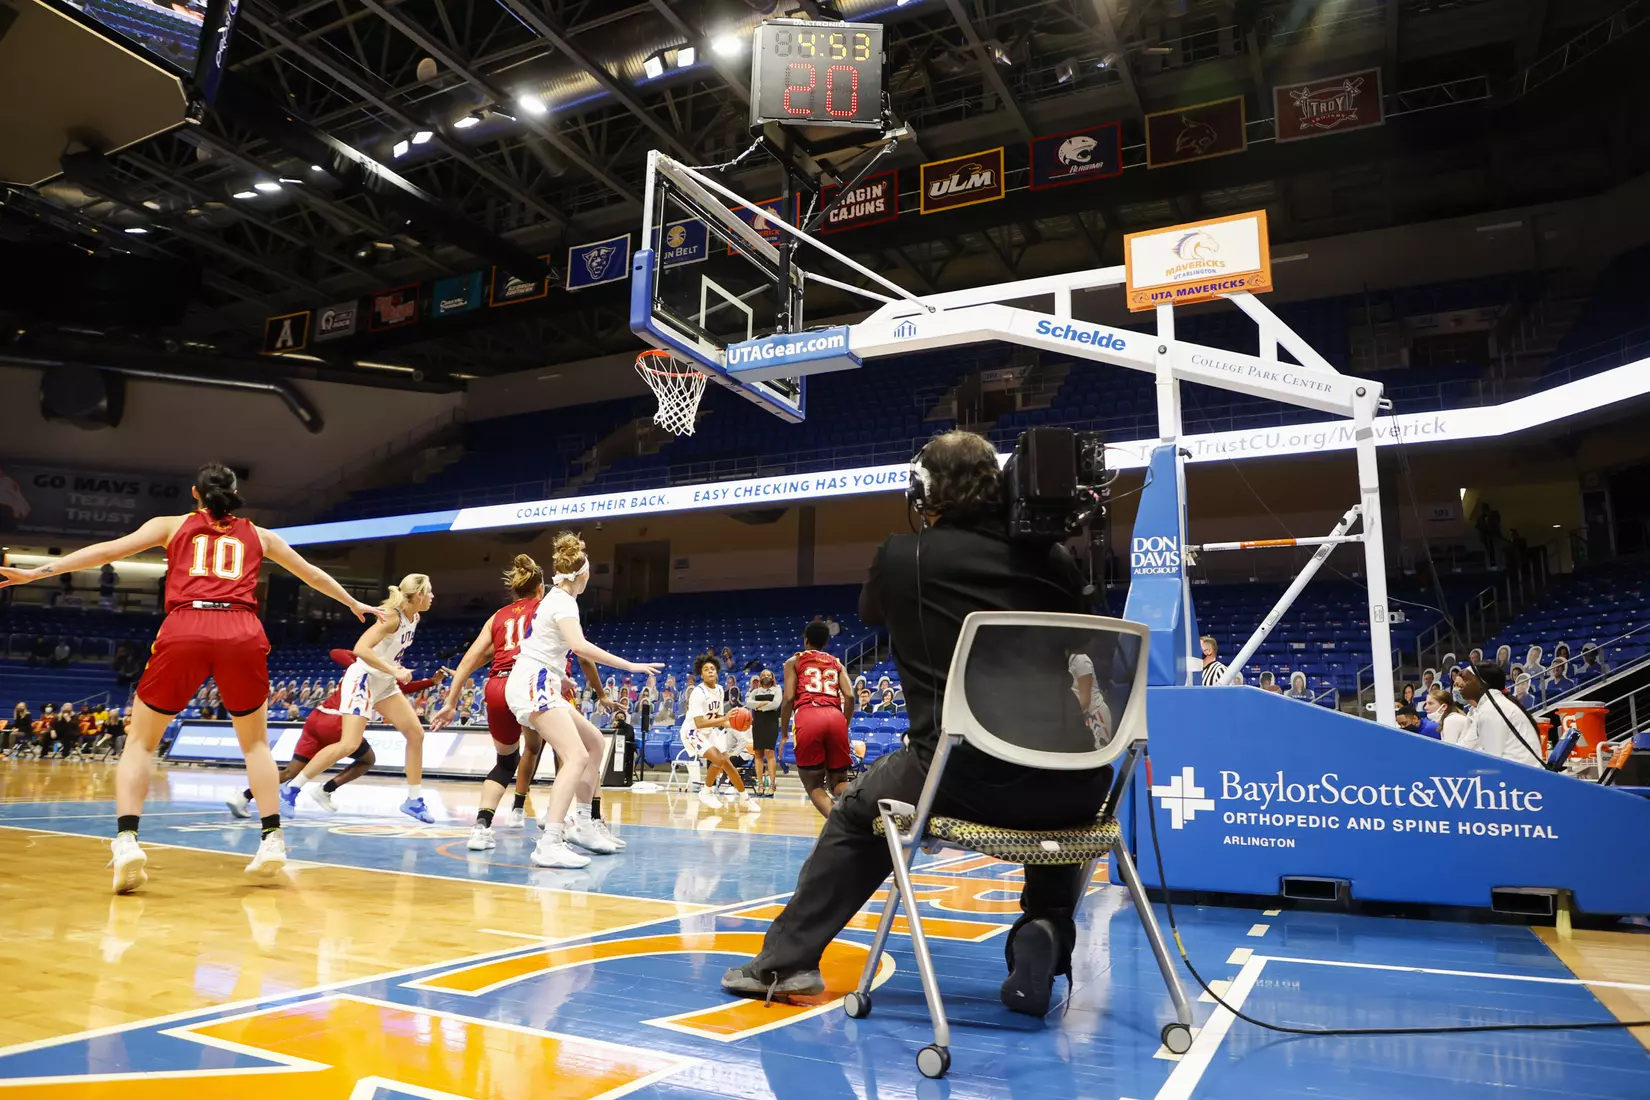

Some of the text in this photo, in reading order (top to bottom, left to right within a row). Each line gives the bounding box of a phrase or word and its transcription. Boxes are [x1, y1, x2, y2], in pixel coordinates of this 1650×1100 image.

[793, 20, 850, 28] DAKTRONICS
[798, 33, 869, 60] 4:53
[784, 63, 858, 117] 20
[1310, 96, 1345, 116] TROY
[837, 181, 887, 206] AGIN'
[929, 169, 993, 198] ULM
[829, 198, 885, 223] CAJUNS
[675, 245, 698, 257] BELT
[1165, 259, 1226, 277] MAVERICKS
[1151, 279, 1246, 301] UTA MAVERICKS
[1035, 319, 1126, 351] Schelde
[728, 333, 844, 365] UTAGear.com
[1191, 354, 1333, 393] COLLEGE PARK CENTER
[1138, 416, 1447, 461] TTrustCU.org/Mverick
[33, 473, 181, 499] GO MAVS GO
[516, 505, 558, 519] COACH
[561, 502, 586, 514] HAS
[590, 498, 627, 512] THEIR
[630, 494, 670, 508] BACK.
[693, 487, 730, 502] EASY
[733, 480, 810, 498] CHECKING
[815, 476, 847, 491] HAS
[66, 492, 136, 509] TEXAS
[65, 507, 136, 524] TRUST
[189, 533, 244, 580] 10
[1133, 535, 1177, 553] DON
[1131, 550, 1180, 568] DAVIS
[804, 666, 839, 697] 32
[1223, 811, 1559, 840] ORTHOPEDIC AND SPINE HOSPITAL
[1223, 834, 1296, 848] ARLINGTON
